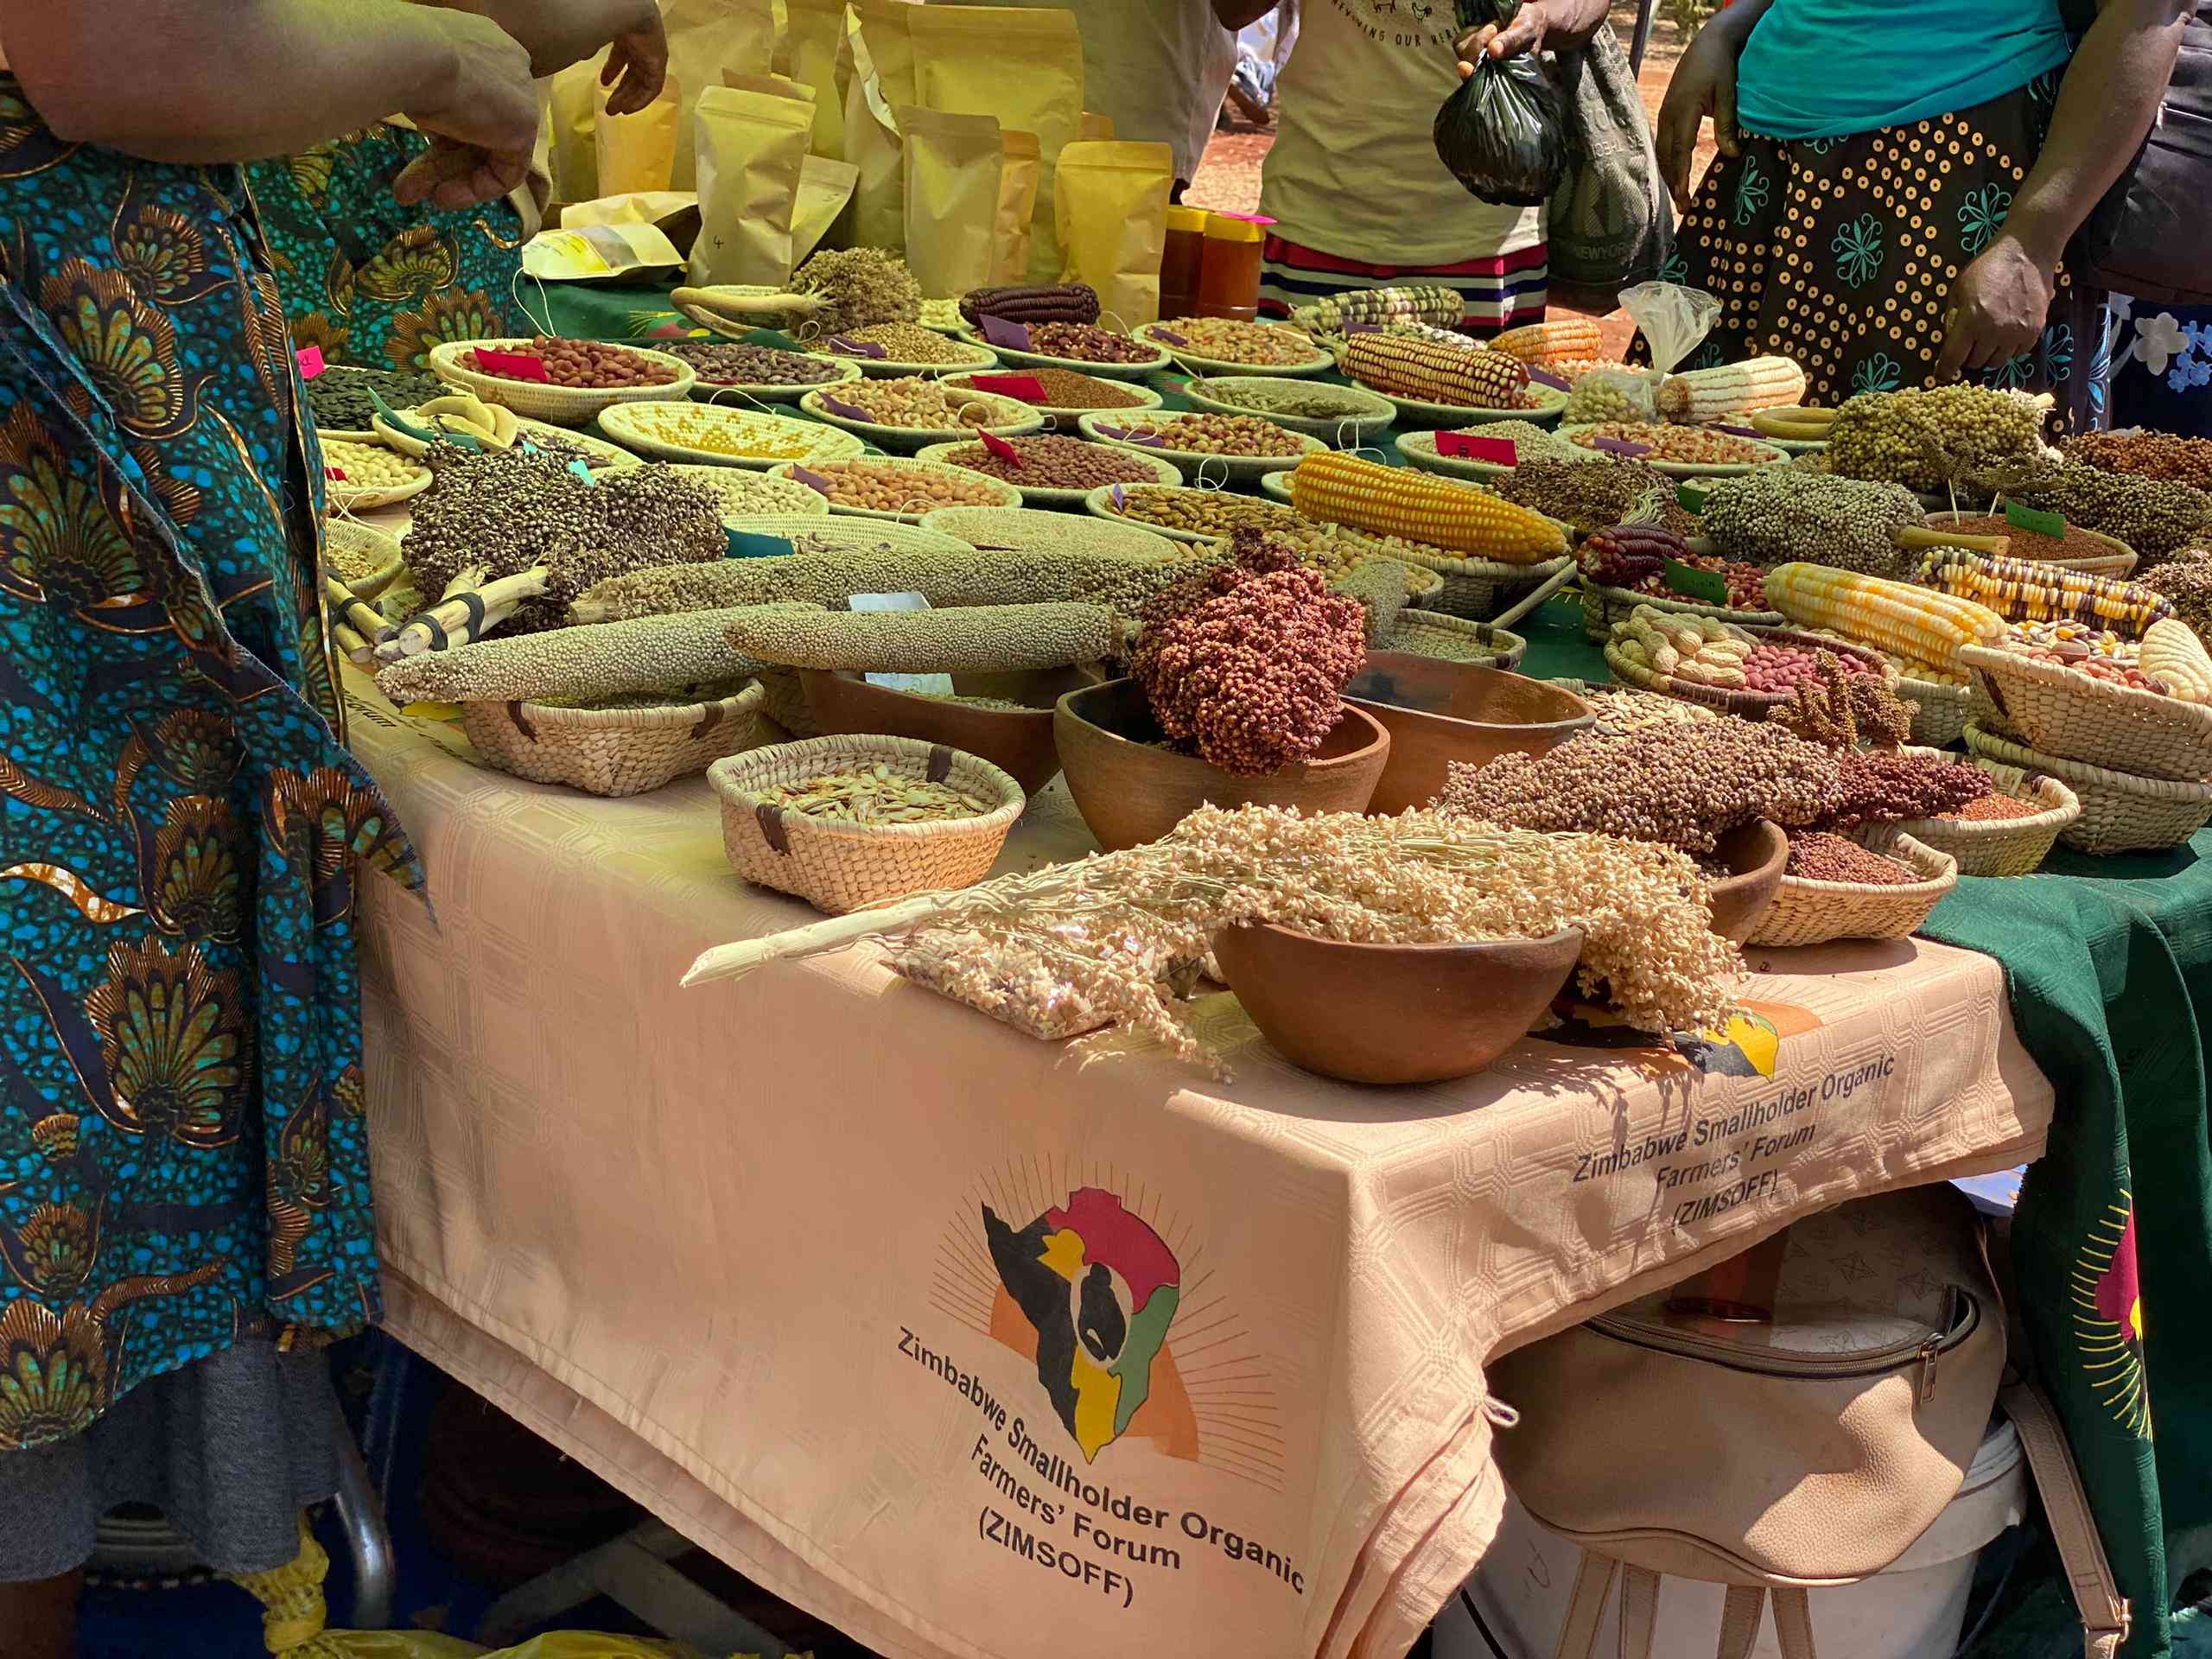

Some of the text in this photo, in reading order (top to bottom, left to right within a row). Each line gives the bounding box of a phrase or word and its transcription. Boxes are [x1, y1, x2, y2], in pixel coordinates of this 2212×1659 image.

[1395, 34, 1421, 47] OUR
[1573, 1054, 1895, 1182] Zimbabwe Smallholder Organic
[1750, 1124, 1815, 1163] Forum
[1671, 1168, 1778, 1236] (ZIMSOFF)
[898, 1325, 1305, 1595] Zimbabwe Smallholder Organic
[978, 1506, 1134, 1608] (ZIMSOFF)
[1073, 1512, 1181, 1569] Forum
